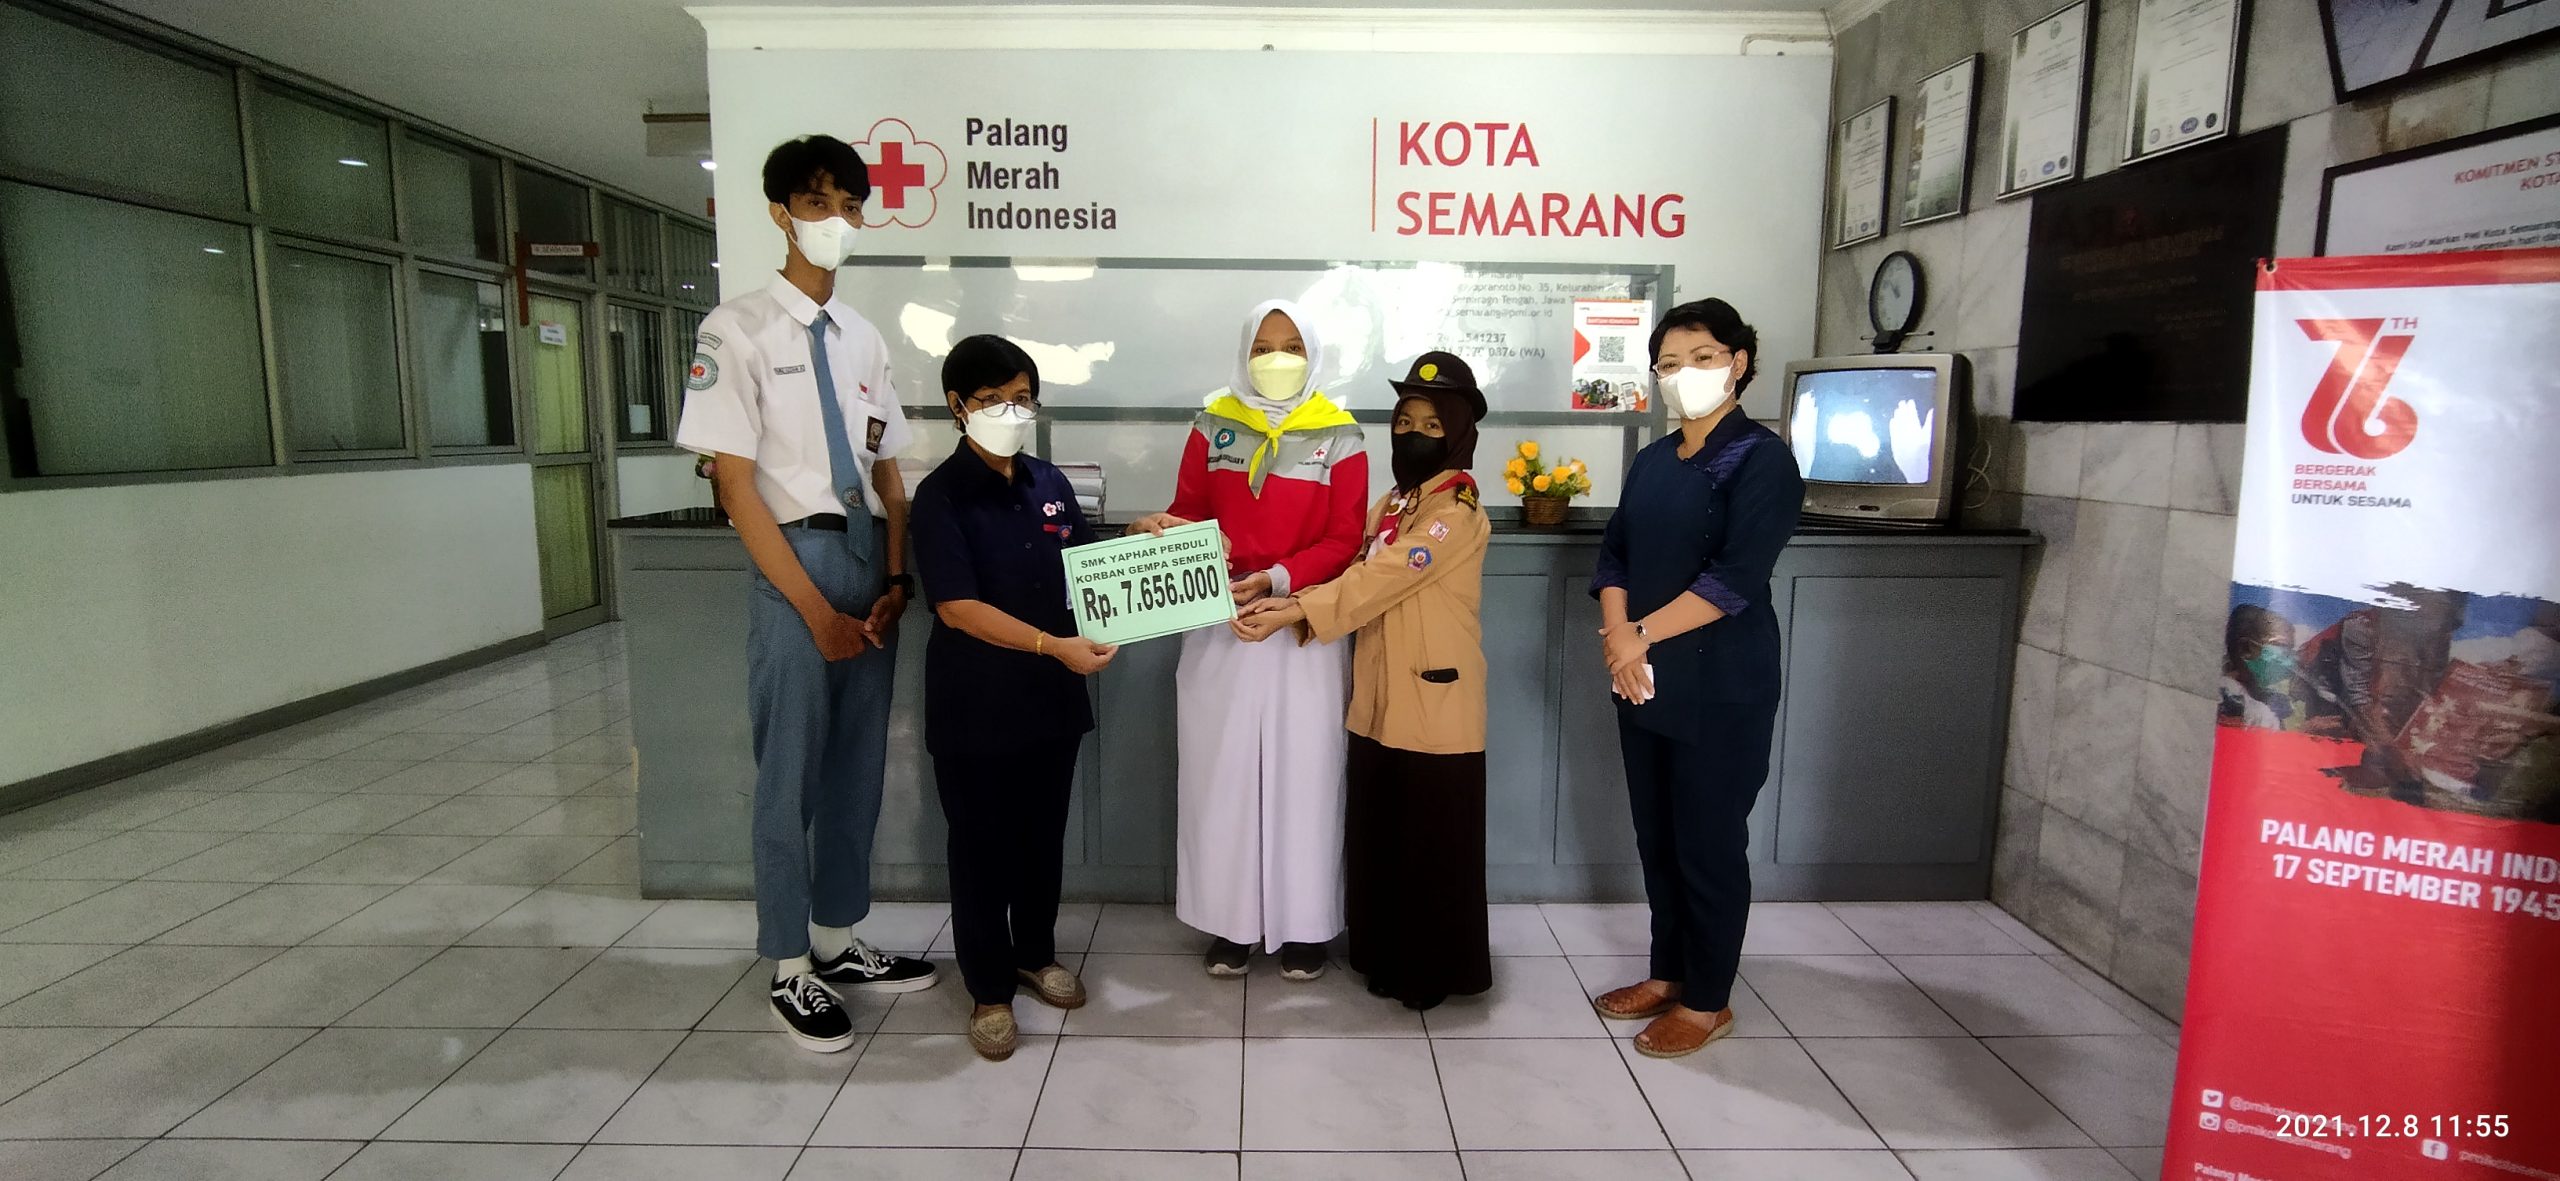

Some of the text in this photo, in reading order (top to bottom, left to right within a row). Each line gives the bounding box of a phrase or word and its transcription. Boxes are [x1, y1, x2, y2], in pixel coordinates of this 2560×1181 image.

[966, 117, 1068, 152] Palang
[1399, 121, 1540, 167] KOTA
[967, 161, 1060, 190] Merah
[2455, 156, 2539, 184] KOMITMEN
[968, 201, 1117, 230] Indonesia
[1396, 191, 1686, 239] SEMARANG
[1519, 347, 1546, 359] (WA)
[2294, 317, 2419, 460] 76 TH
[2292, 479, 2367, 492] BERSAMA
[2294, 464, 2376, 477] BERGERAK
[2291, 493, 2412, 509] UNTUK SESAMA
[1075, 550, 1218, 584] KORBAN GEMPA SEMERU
[1081, 538, 1209, 569] SMK YAPHAR PERDULI
[1081, 564, 1220, 628] Rp. 7.656.000
[2260, 818, 2560, 885] PALANG MERAH IND
[2273, 853, 2560, 921] 17 SEPTEMBER 1945
